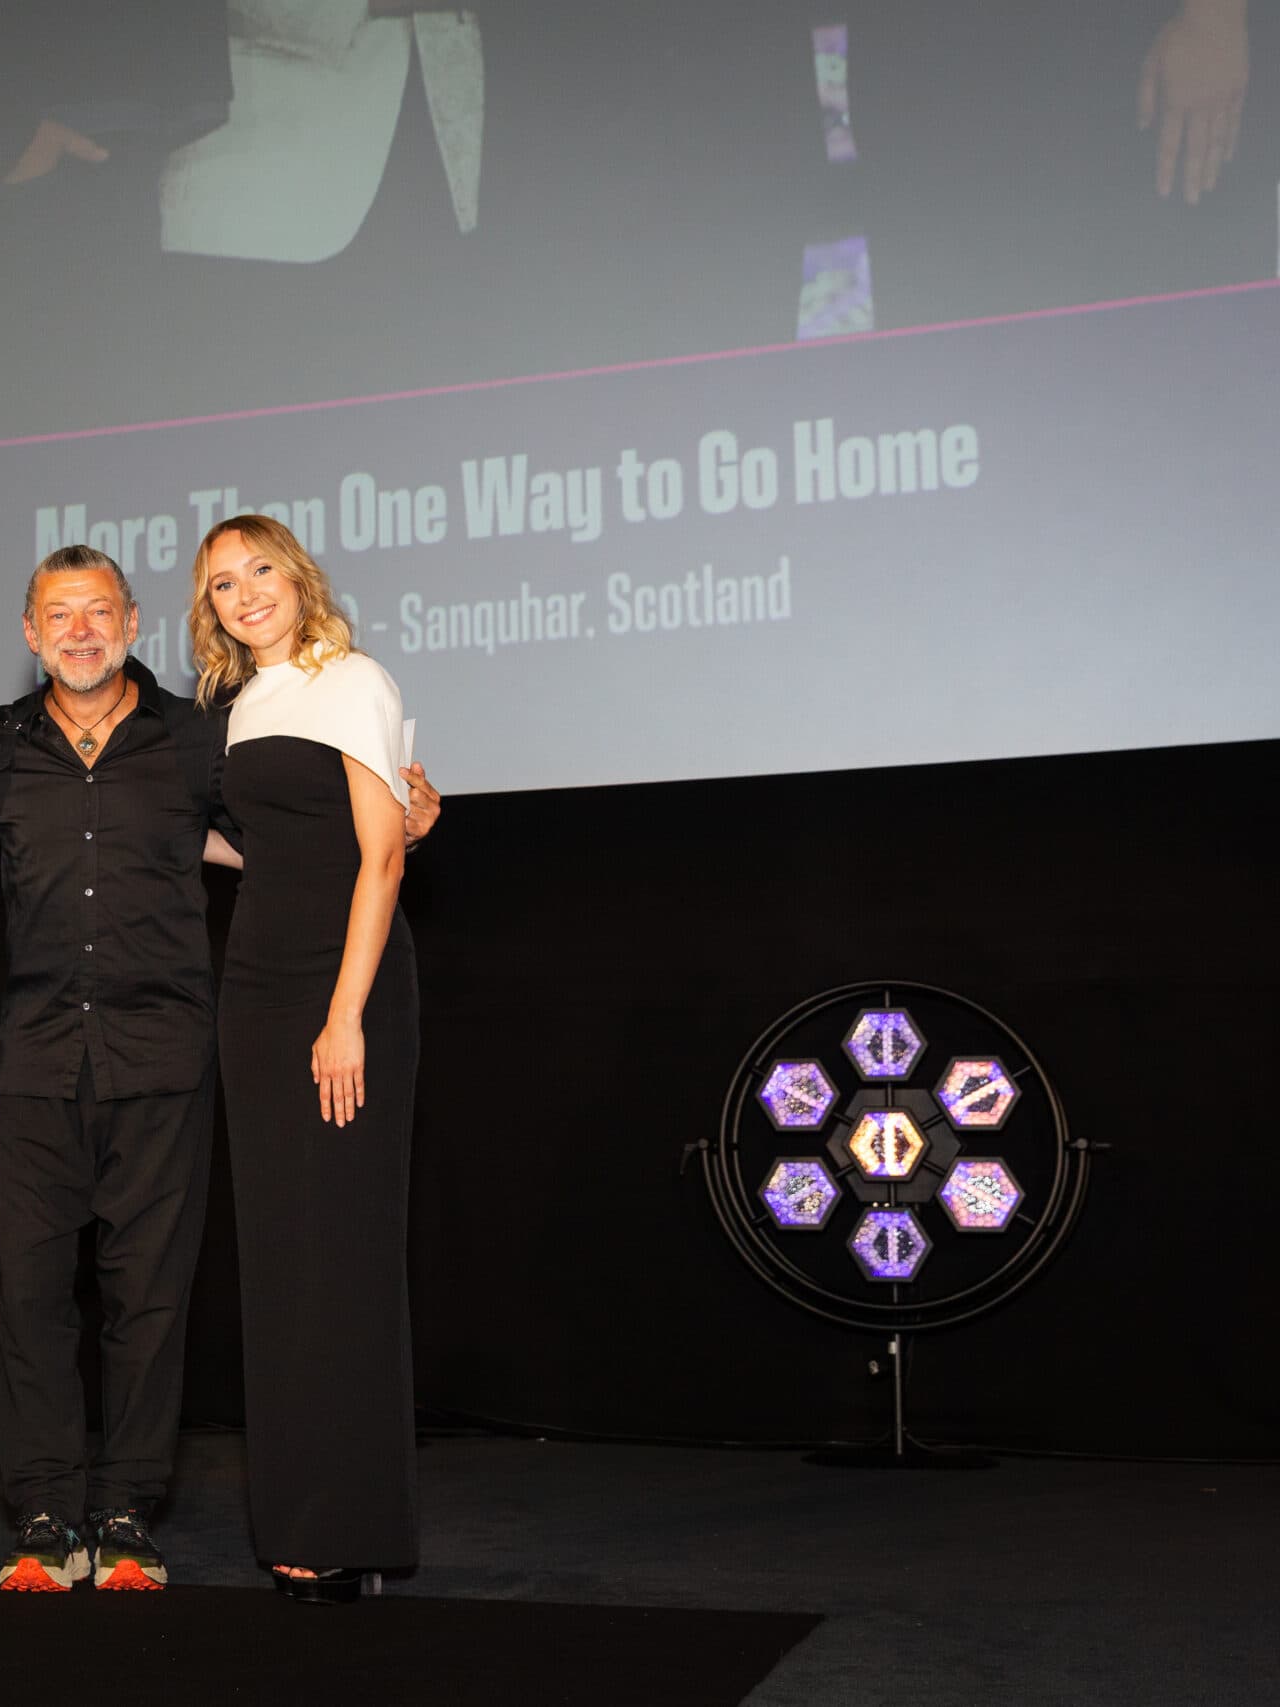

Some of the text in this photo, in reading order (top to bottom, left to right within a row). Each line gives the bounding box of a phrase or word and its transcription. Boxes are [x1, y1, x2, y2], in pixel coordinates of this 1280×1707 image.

[340, 472, 447, 552] One
[461, 454, 603, 543] Way
[618, 449, 684, 522] to
[699, 429, 779, 514] Go
[793, 418, 980, 504] Home
[607, 555, 792, 634] Scotland
